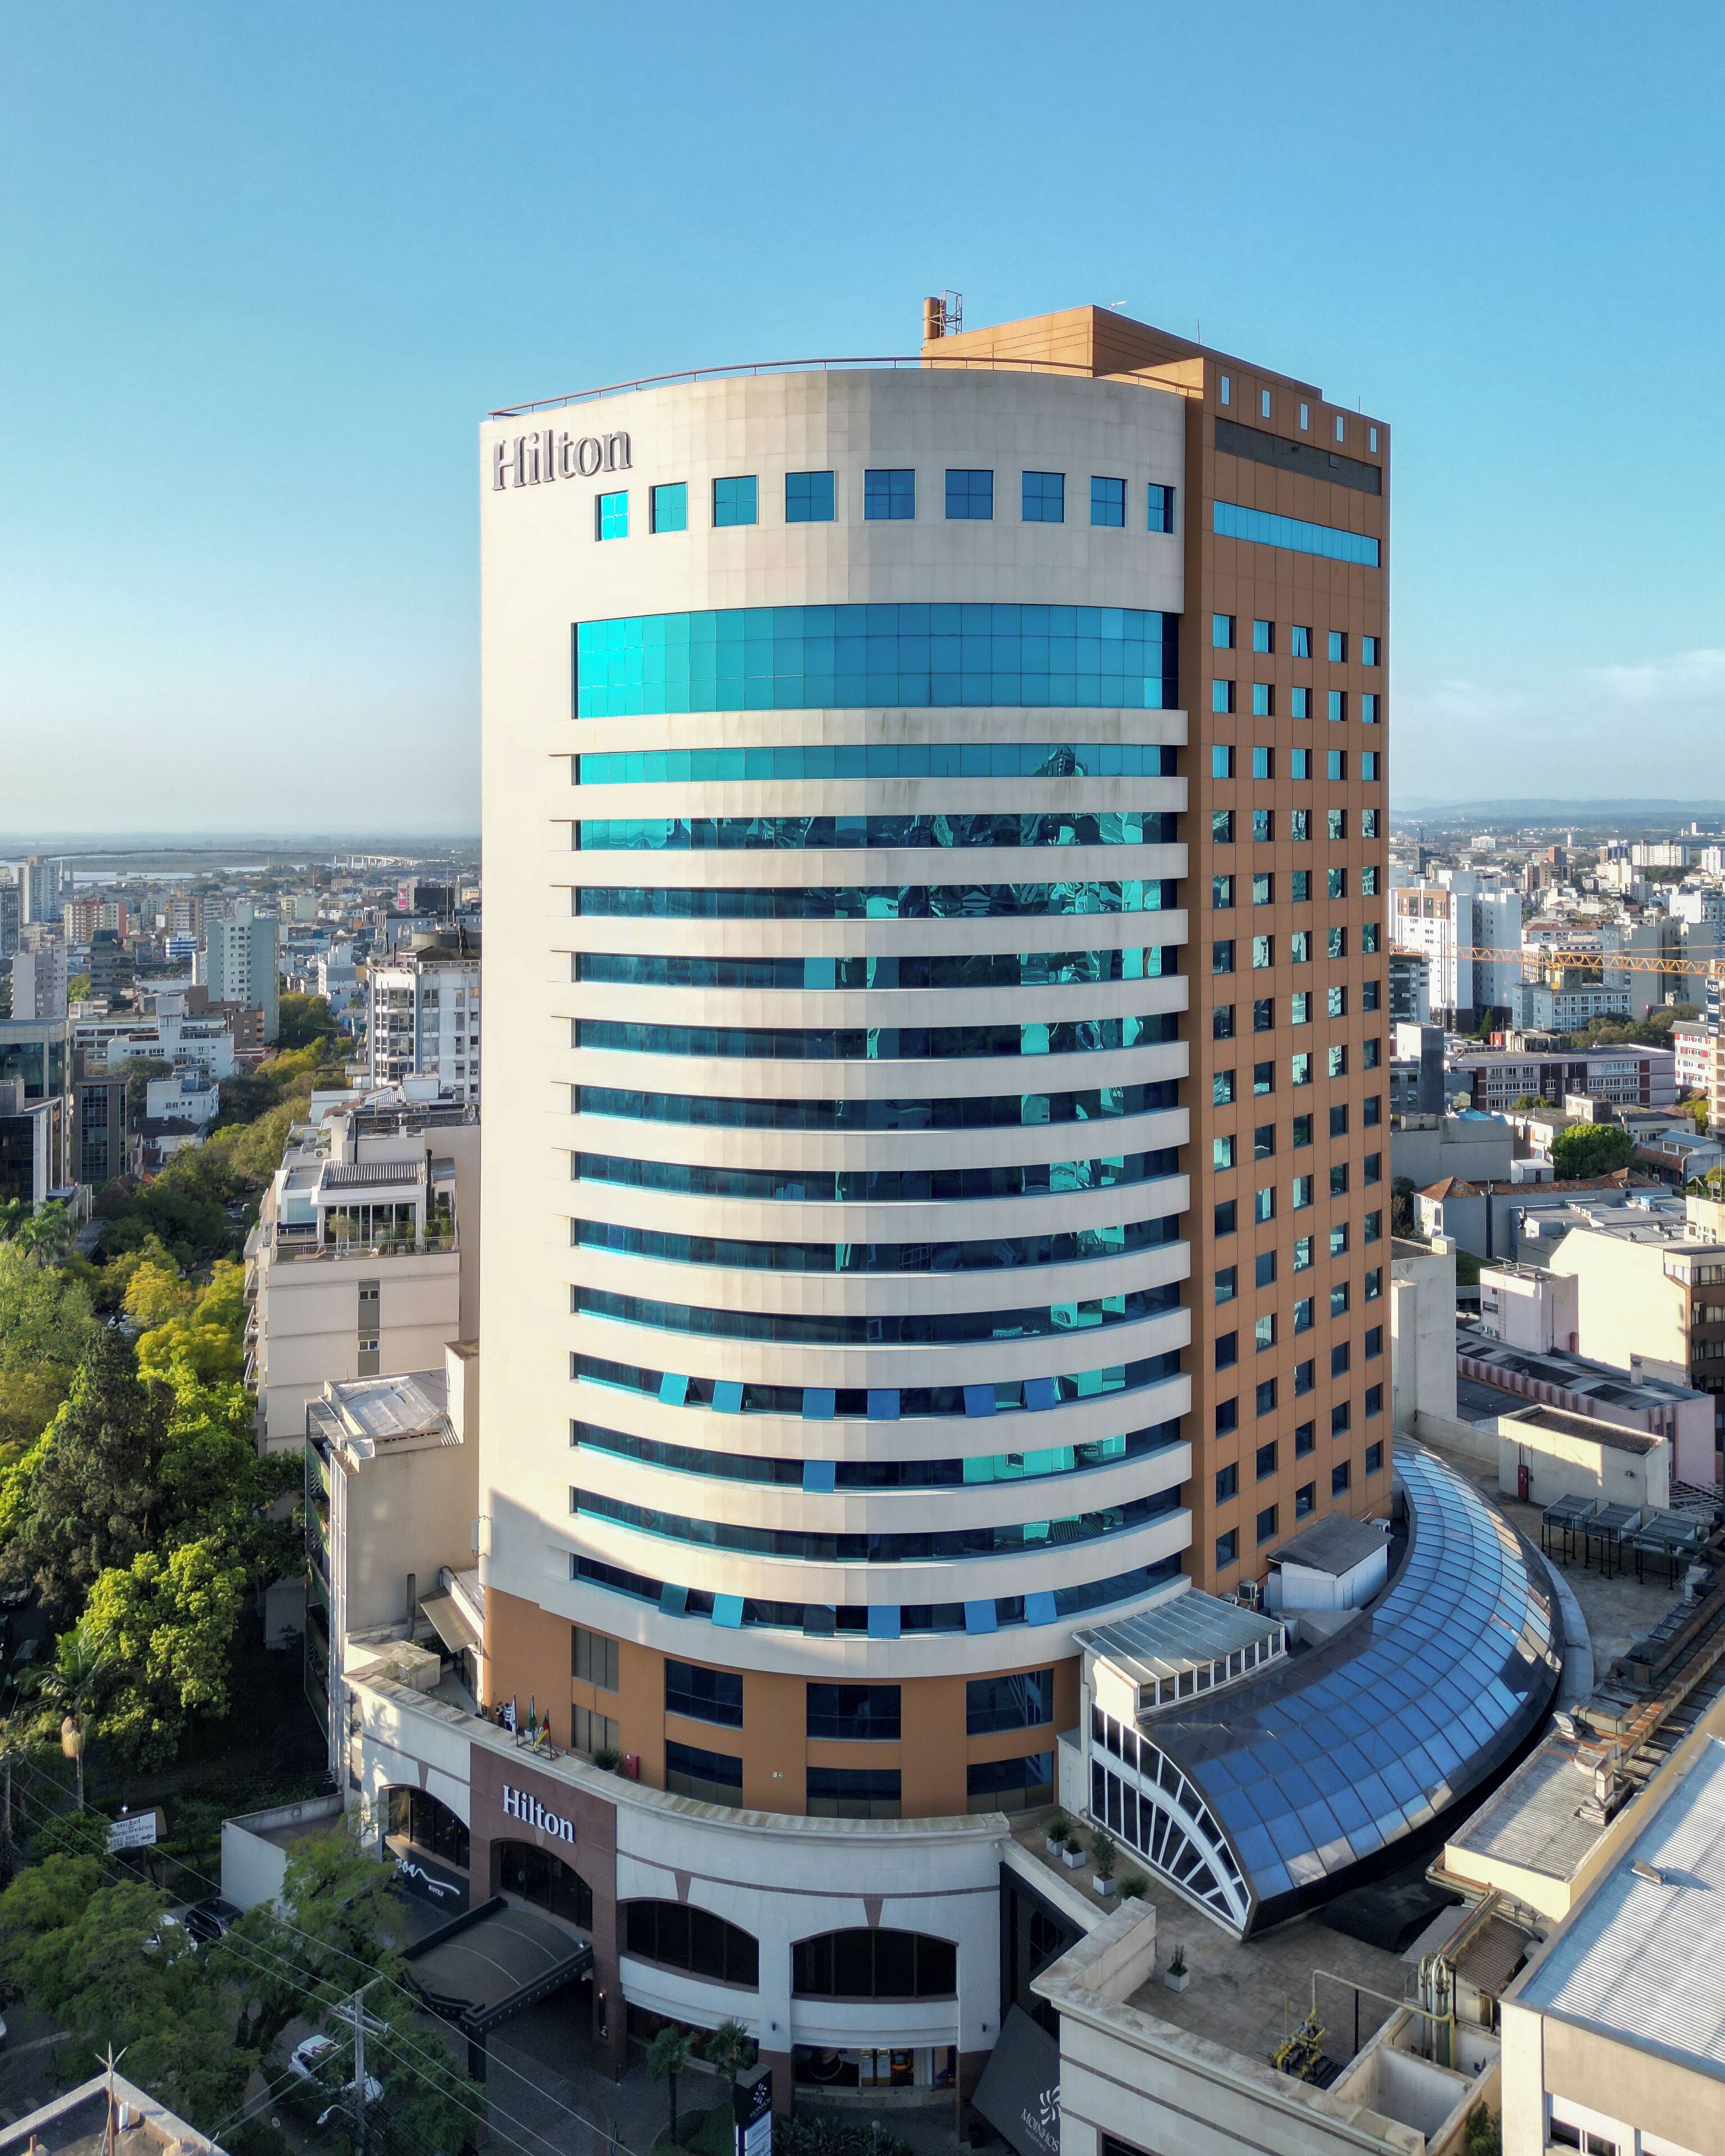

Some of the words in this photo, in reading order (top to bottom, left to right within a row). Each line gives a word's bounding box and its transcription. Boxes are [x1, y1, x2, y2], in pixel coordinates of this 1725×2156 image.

[492, 429, 633, 491] Hilton
[503, 1784, 574, 1844] Hilton
[1021, 2108, 1060, 2152] MOINHOS
